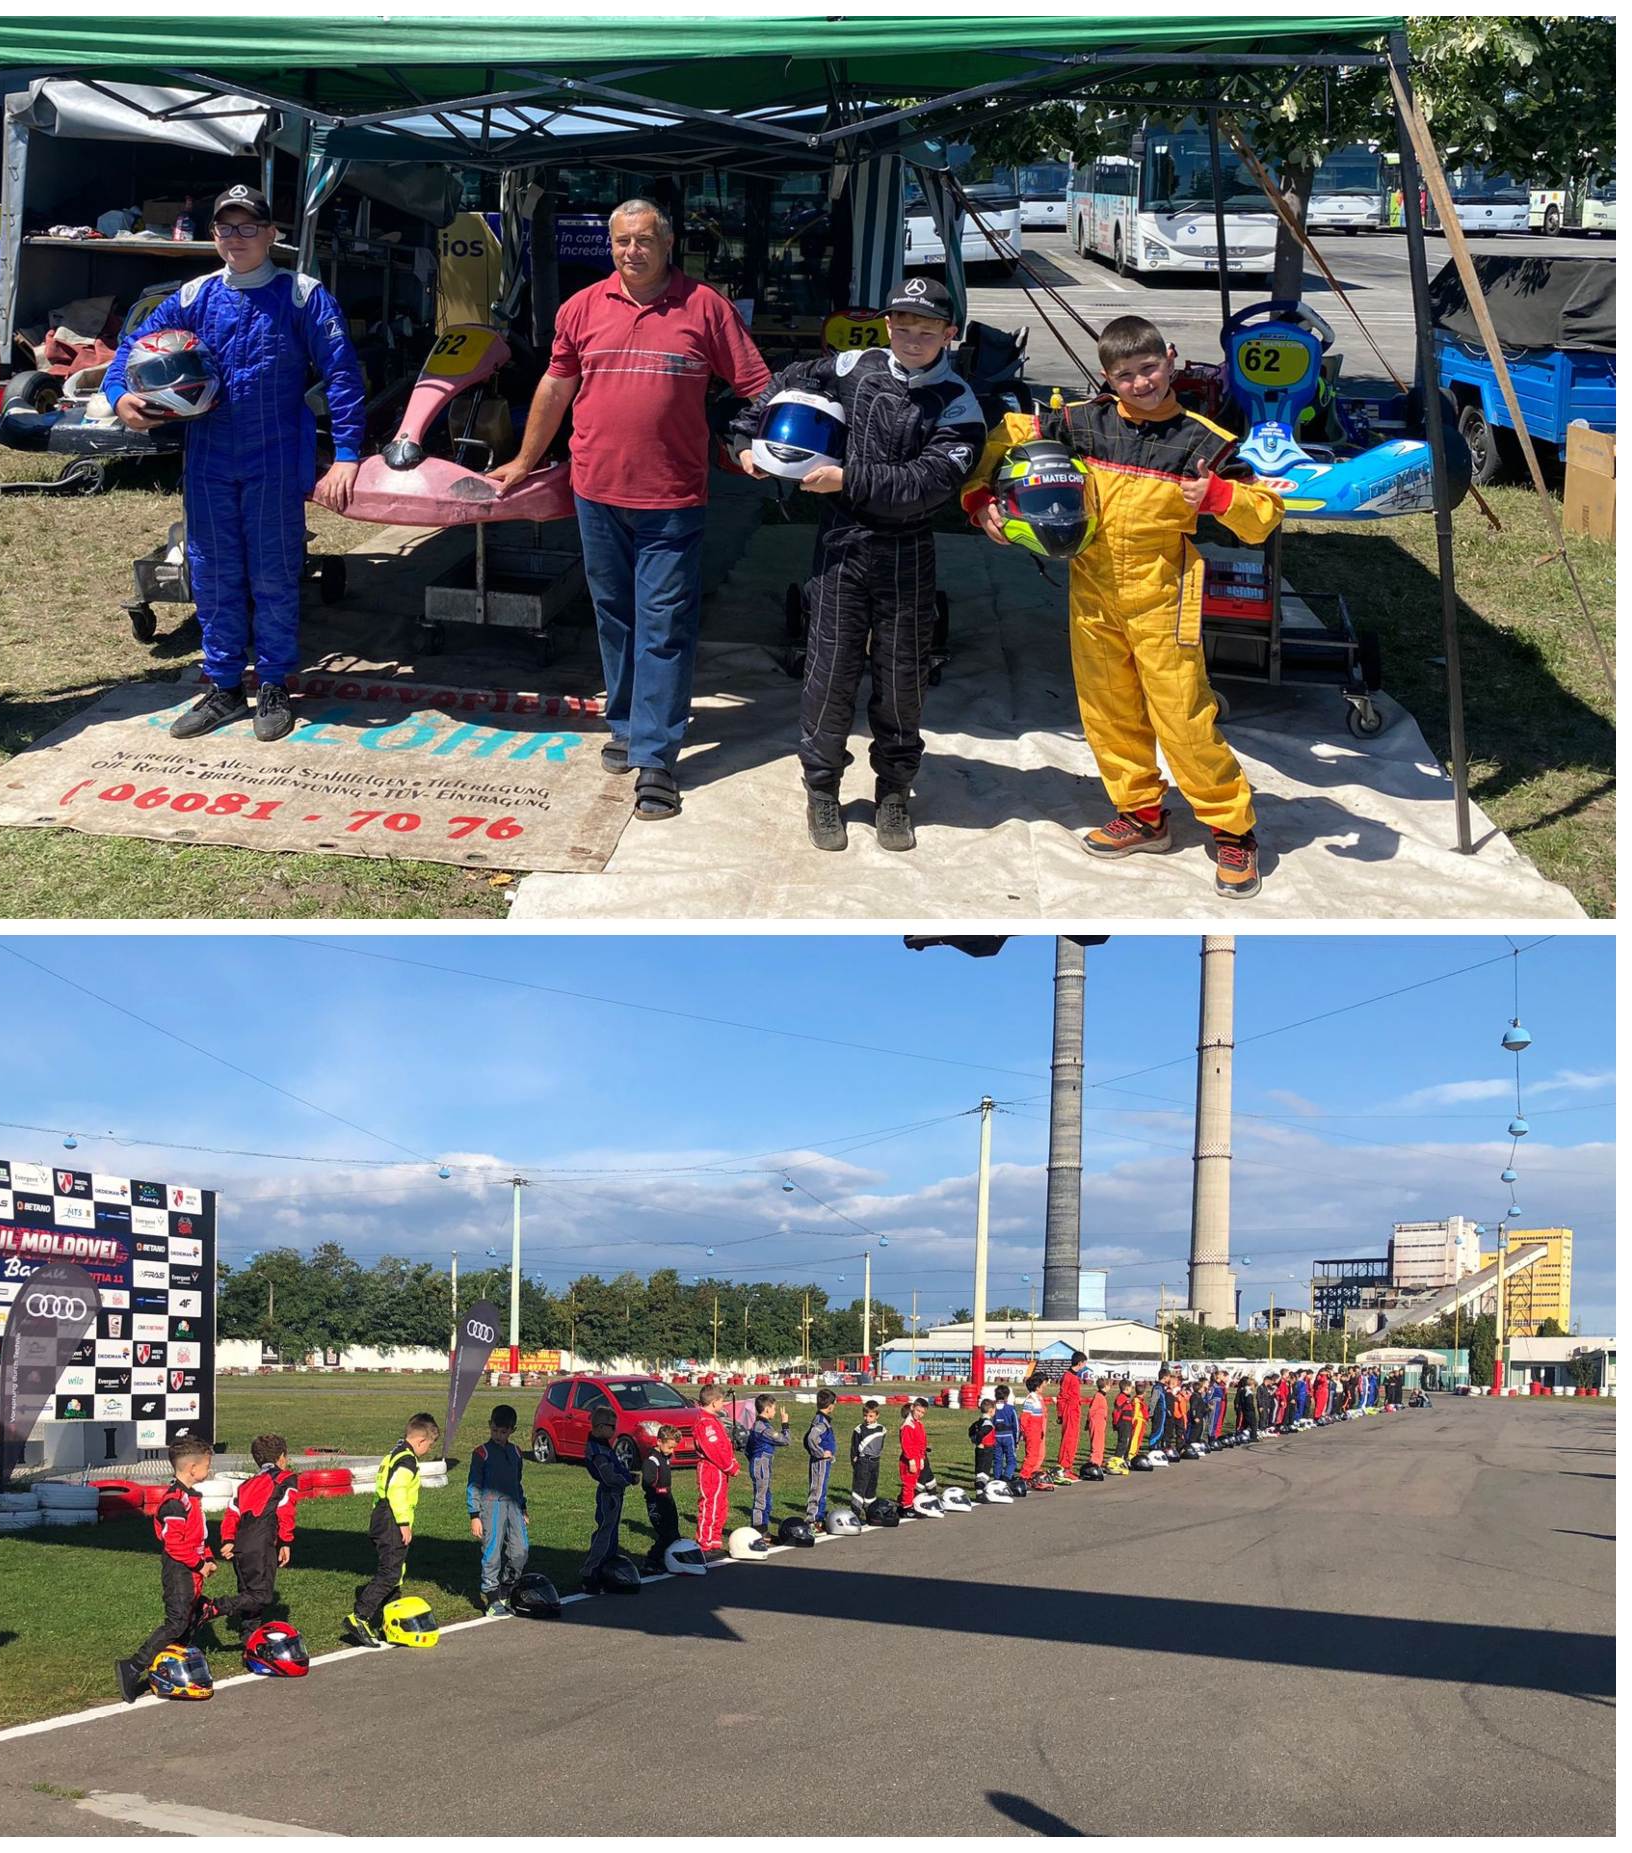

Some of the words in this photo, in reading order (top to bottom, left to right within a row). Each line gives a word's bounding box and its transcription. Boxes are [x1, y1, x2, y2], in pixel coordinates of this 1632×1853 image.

[434, 334, 467, 356] 62
[848, 327, 879, 347] 52
[1244, 348, 1280, 372] 62
[1042, 474, 1067, 484] MATEI
[98, 783, 284, 820] 06081
[345, 810, 422, 832] 70
[447, 816, 524, 840] 76
[24, 1201, 51, 1213] BETANO
[21, 1231, 118, 1259] MOLDOVEI
[986, 1367, 1024, 1376] Aventi.ro
[141, 1402, 157, 1414] 4F
